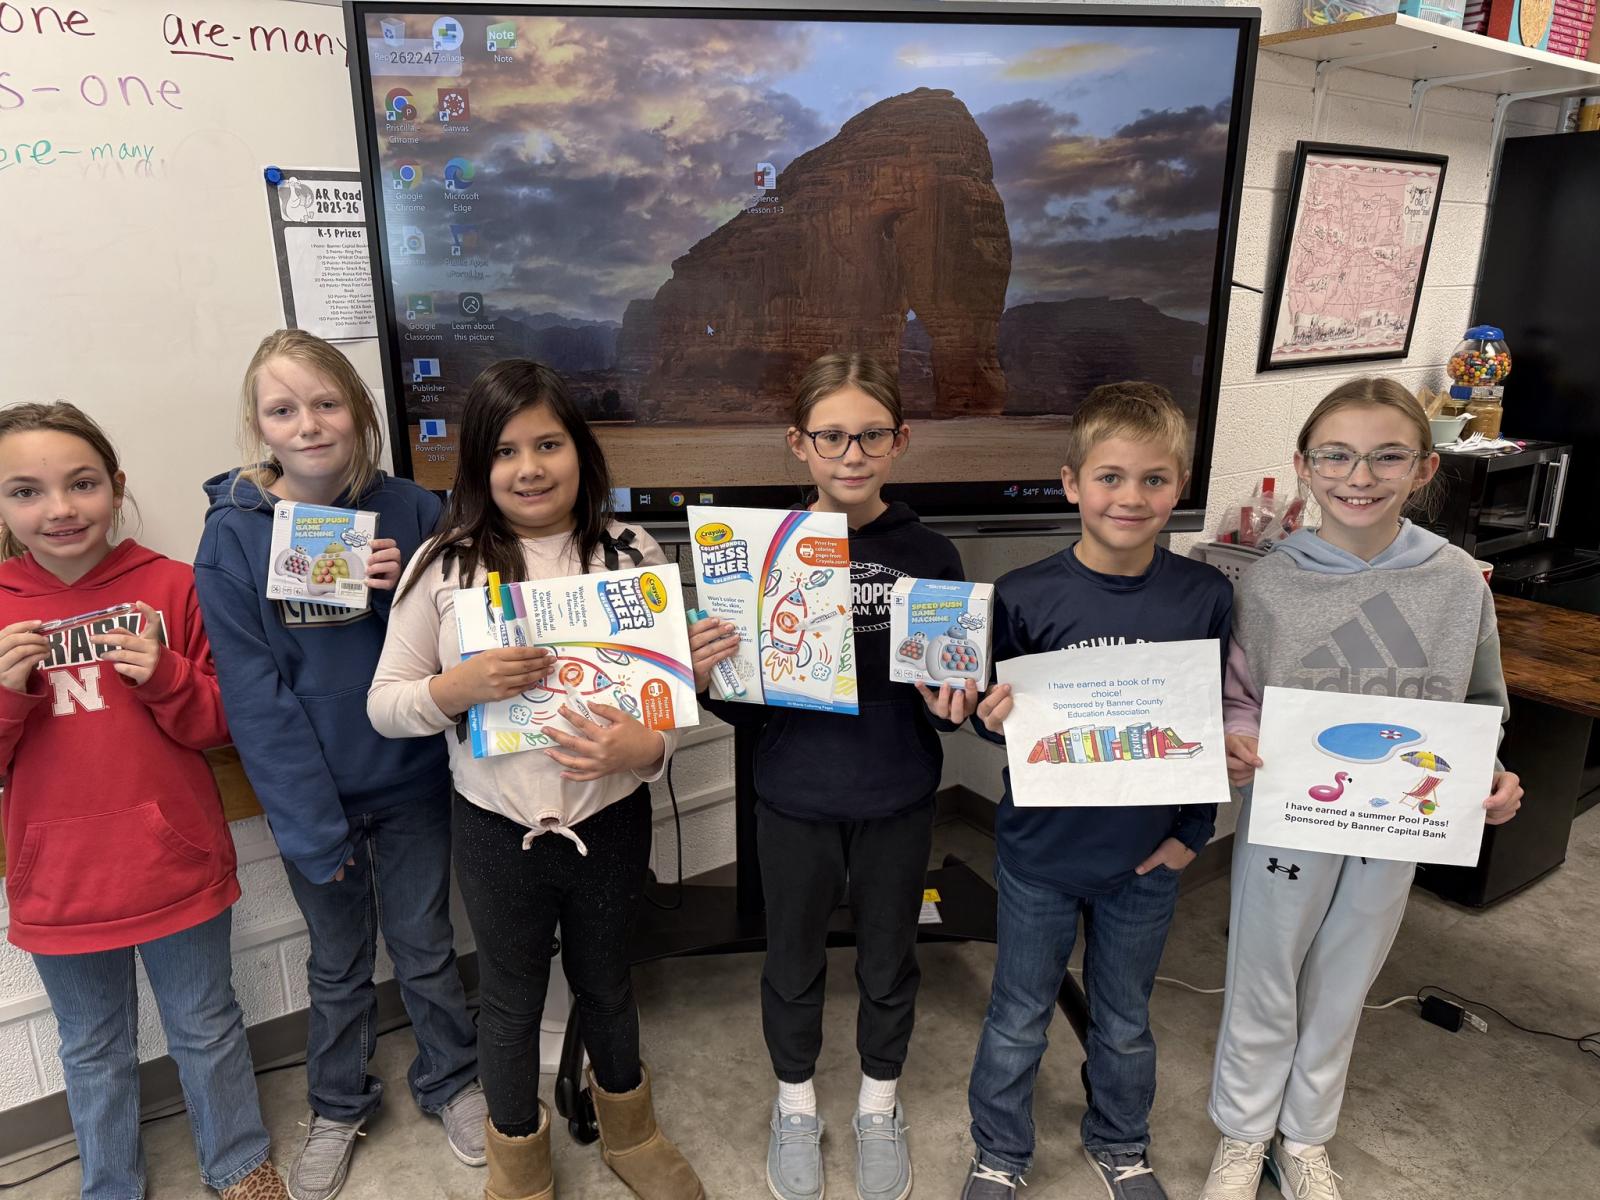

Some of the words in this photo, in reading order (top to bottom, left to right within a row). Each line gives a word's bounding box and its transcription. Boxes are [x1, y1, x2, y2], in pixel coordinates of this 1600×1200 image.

[0, 3, 96, 37] one
[489, 31, 515, 40] Note
[390, 52, 440, 65] 262247
[495, 55, 513, 63] Note
[443, 124, 469, 132] Canvas
[390, 135, 419, 144] Chrome
[315, 188, 331, 201] AR
[334, 188, 362, 201] Road
[396, 192, 423, 202] Google
[444, 192, 480, 201] Microsoft
[316, 201, 359, 214] 2025-26
[396, 204, 426, 212] Chrome
[453, 204, 472, 213] Edge
[773, 206, 785, 214] 1-3
[317, 228, 332, 238] K-5
[334, 228, 361, 238] Prizes
[409, 322, 436, 331] Google
[452, 322, 472, 330] Learn
[474, 322, 495, 330] about
[469, 334, 495, 342] picture
[412, 384, 446, 392] Publisher
[421, 395, 439, 403] 2016
[428, 455, 446, 463] 2016
[296, 517, 325, 525] SPEED
[295, 530, 335, 538] MACHINE
[700, 529, 727, 537] Crayola
[701, 546, 747, 564] MESS
[704, 560, 749, 577] FREE
[649, 579, 663, 606] Crayola
[531, 589, 539, 612] Markers
[620, 580, 647, 628] MESS
[605, 583, 633, 629] FREE
[567, 599, 575, 626] furniture!
[541, 609, 549, 631] Wonder
[911, 616, 950, 624] MACHINE
[1076, 680, 1107, 688] earned
[1117, 678, 1139, 686] book
[1140, 677, 1150, 685] of
[1152, 678, 1166, 686] my
[48, 665, 105, 717] N
[1091, 689, 1122, 698] choice!
[1053, 701, 1093, 711] Sponsored
[1095, 700, 1104, 708] by
[1106, 699, 1134, 707] Banner
[1136, 698, 1164, 706] County
[1067, 709, 1104, 718] Education
[1106, 708, 1150, 717] Association
[1290, 803, 1313, 812] have
[1315, 807, 1347, 817] earned
[1358, 812, 1396, 822] summer
[1399, 815, 1420, 825] Pool
[1422, 818, 1449, 828] Pass!
[1284, 813, 1335, 827] Sponsored
[1337, 820, 1349, 829] by
[1351, 822, 1385, 833] Banner
[1387, 826, 1420, 837] Capital
[1422, 830, 1447, 839] Bank
